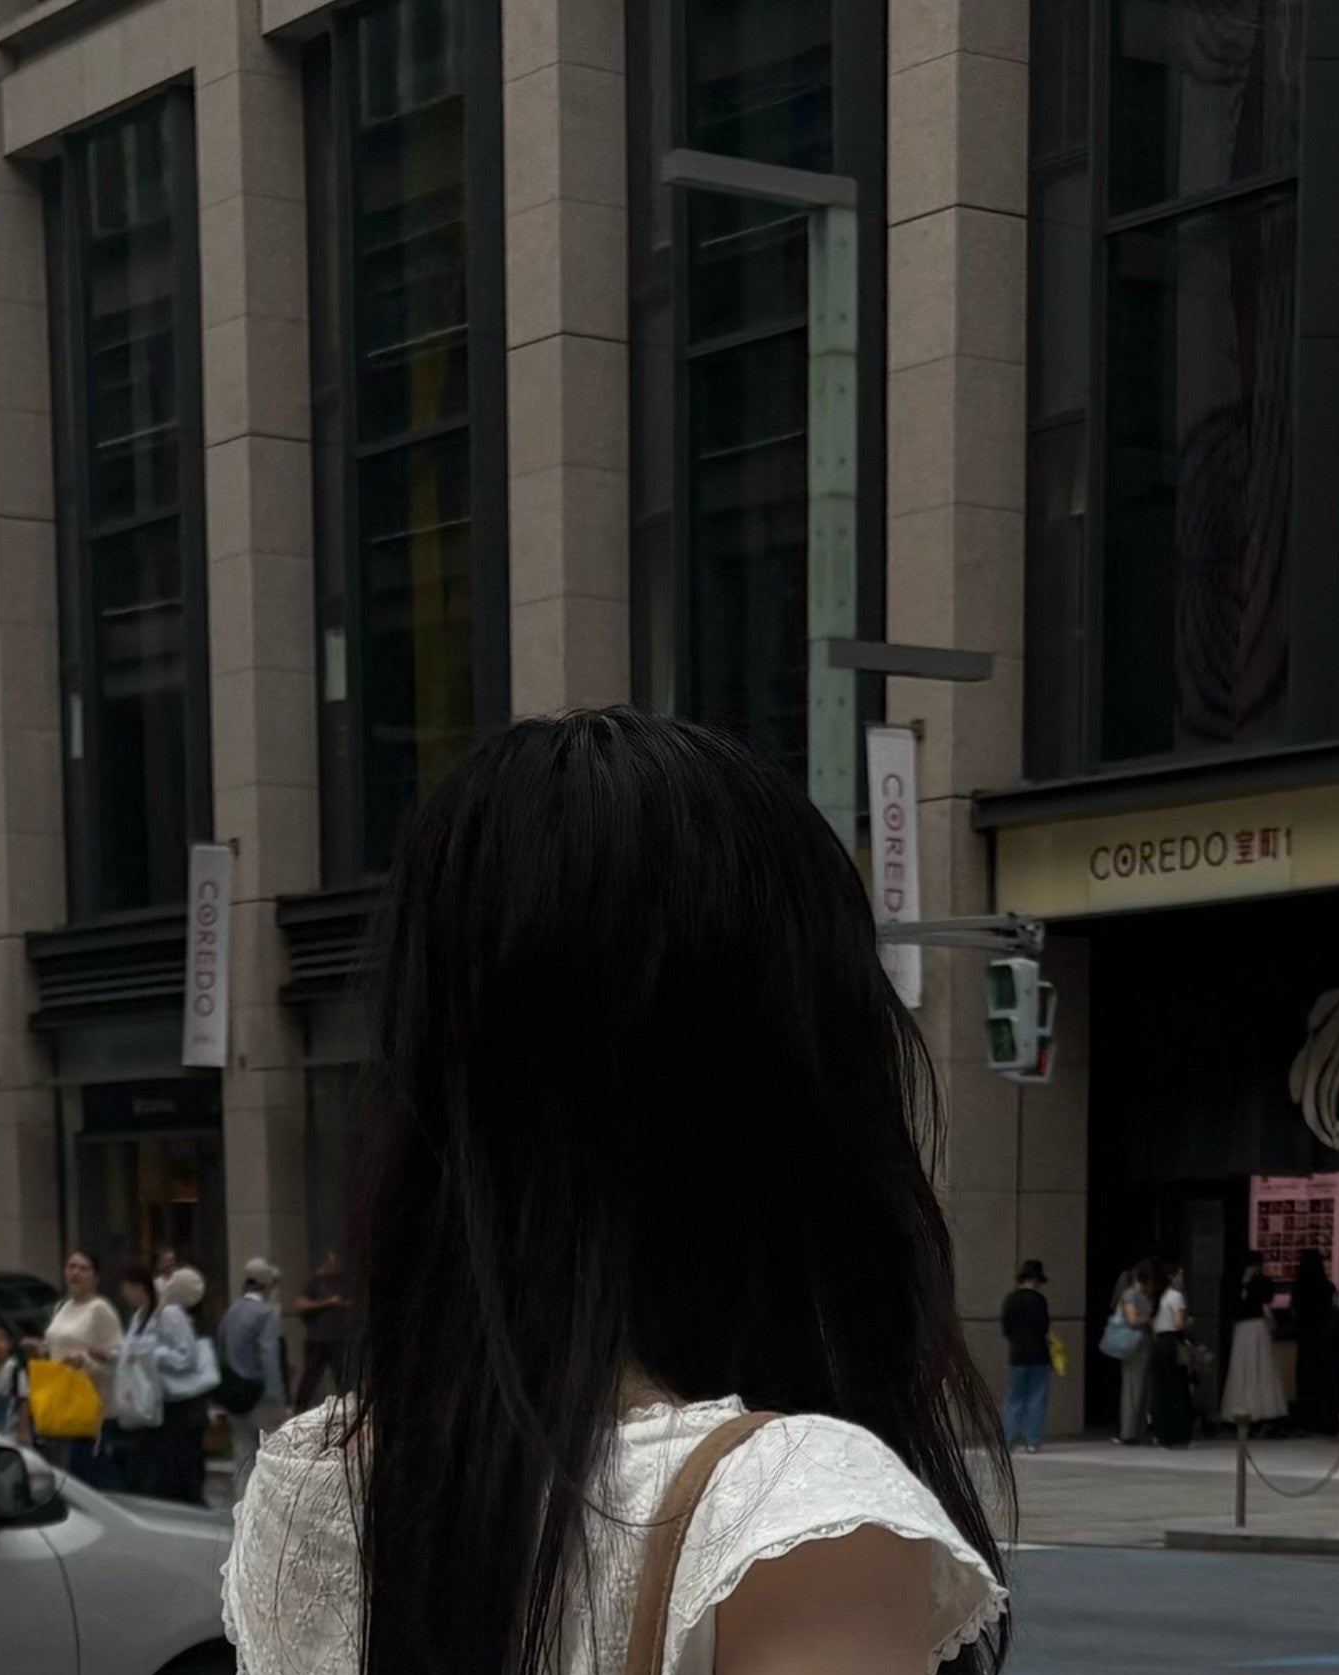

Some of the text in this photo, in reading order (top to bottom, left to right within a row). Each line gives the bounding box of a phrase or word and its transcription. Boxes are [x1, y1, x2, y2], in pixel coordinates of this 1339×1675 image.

[881, 773, 905, 922] CORED
[1090, 831, 1229, 881] COREDO
[194, 880, 219, 1018] COREDO
